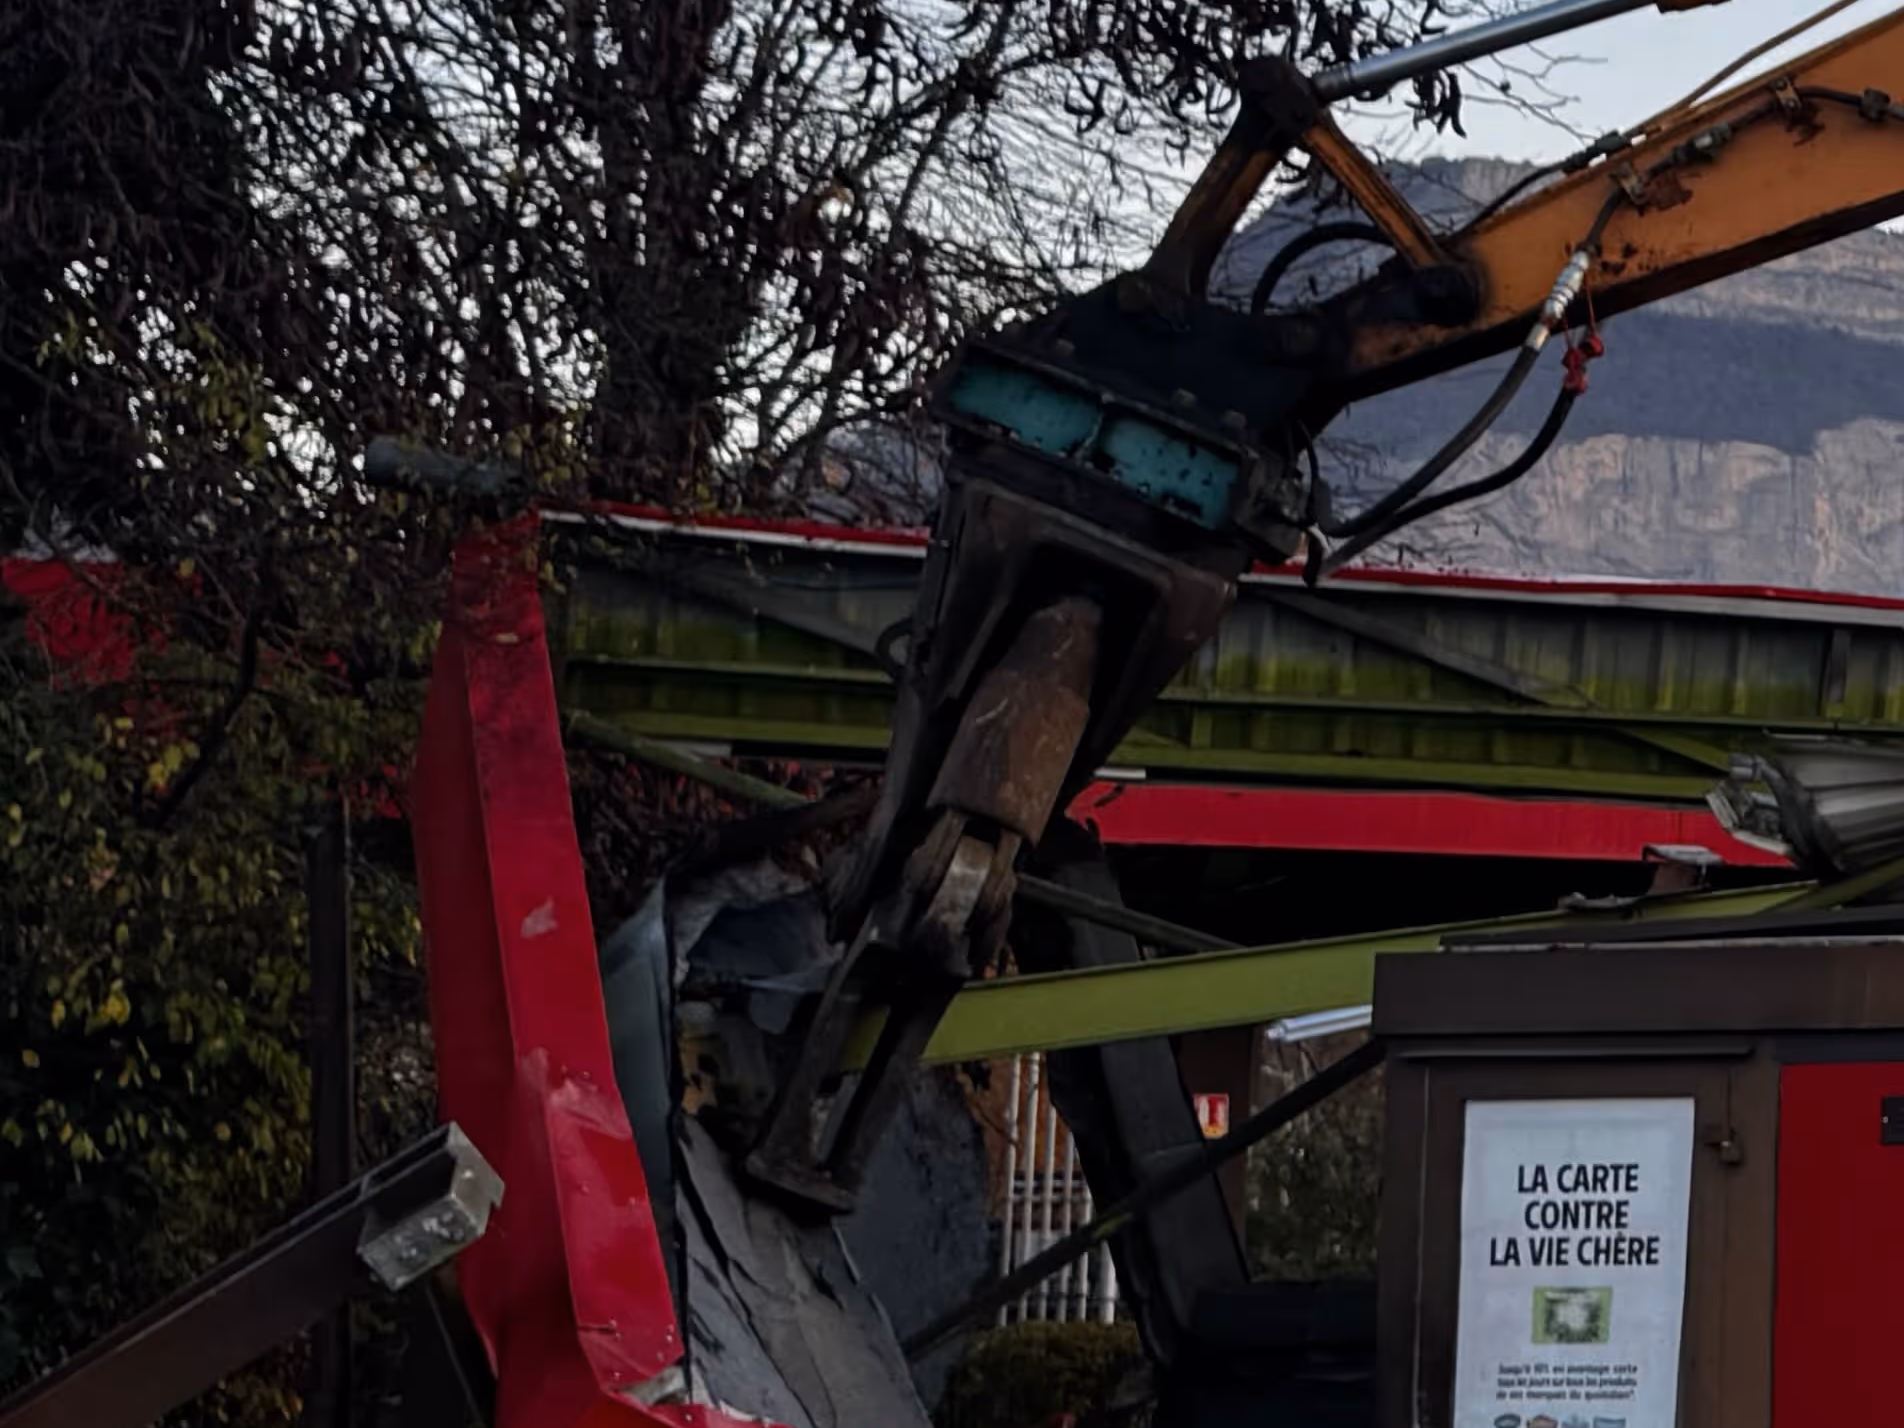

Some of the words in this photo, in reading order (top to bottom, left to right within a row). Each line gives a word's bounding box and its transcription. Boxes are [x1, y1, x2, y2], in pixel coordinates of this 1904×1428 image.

[1518, 1164, 1548, 1193] LA
[1557, 1163, 1639, 1193] CARTE
[1524, 1200, 1629, 1229] CONTRE
[1490, 1237, 1520, 1266] LA
[1529, 1237, 1570, 1266] VIE
[1577, 1232, 1660, 1266] CHÈRE
